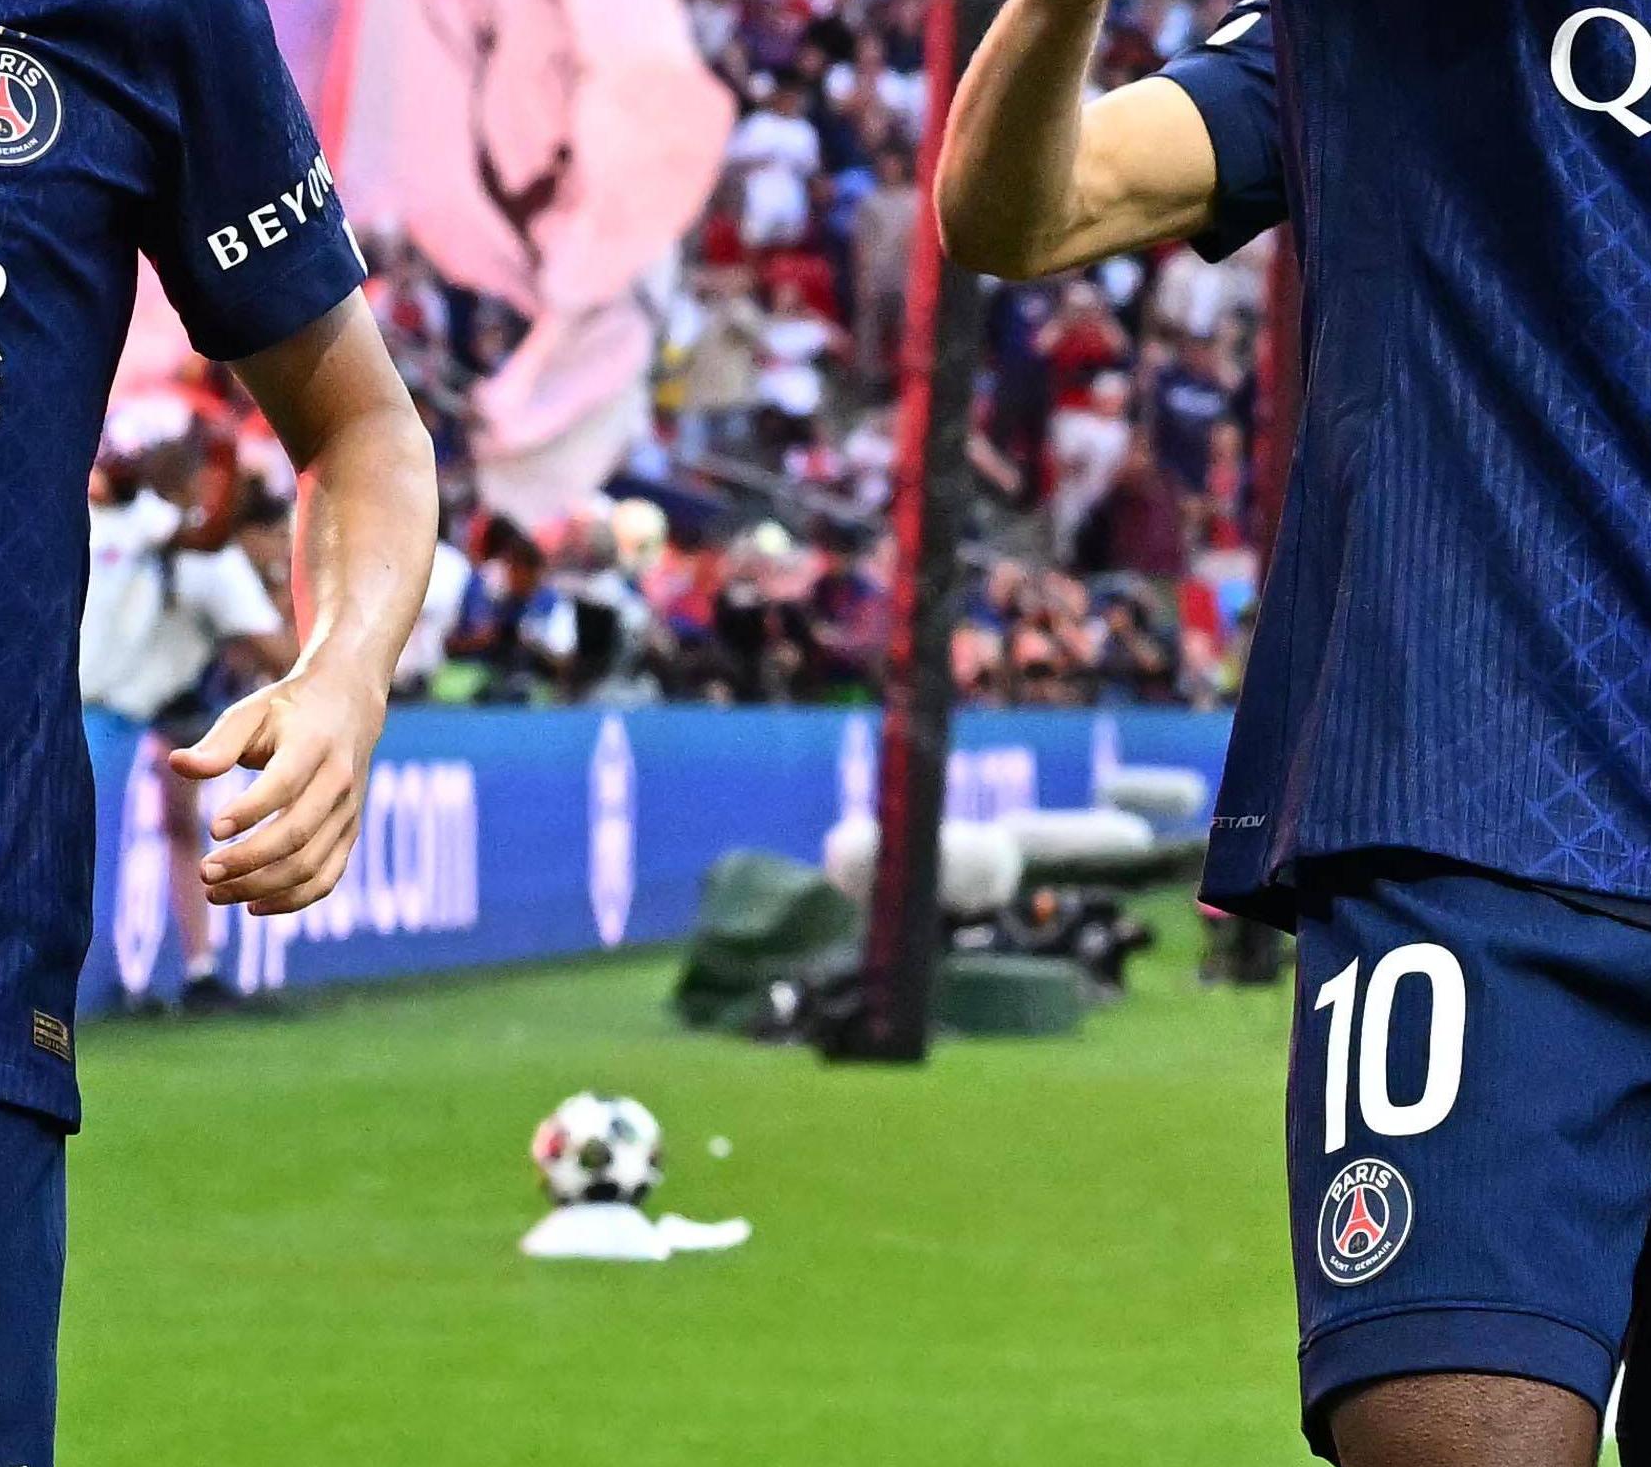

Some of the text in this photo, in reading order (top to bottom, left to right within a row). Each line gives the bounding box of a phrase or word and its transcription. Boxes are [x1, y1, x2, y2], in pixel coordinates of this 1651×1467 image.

[207, 148, 333, 271] BEYON
[1314, 943, 1466, 1154] 10
[1331, 1165, 1392, 1203] PARIS
